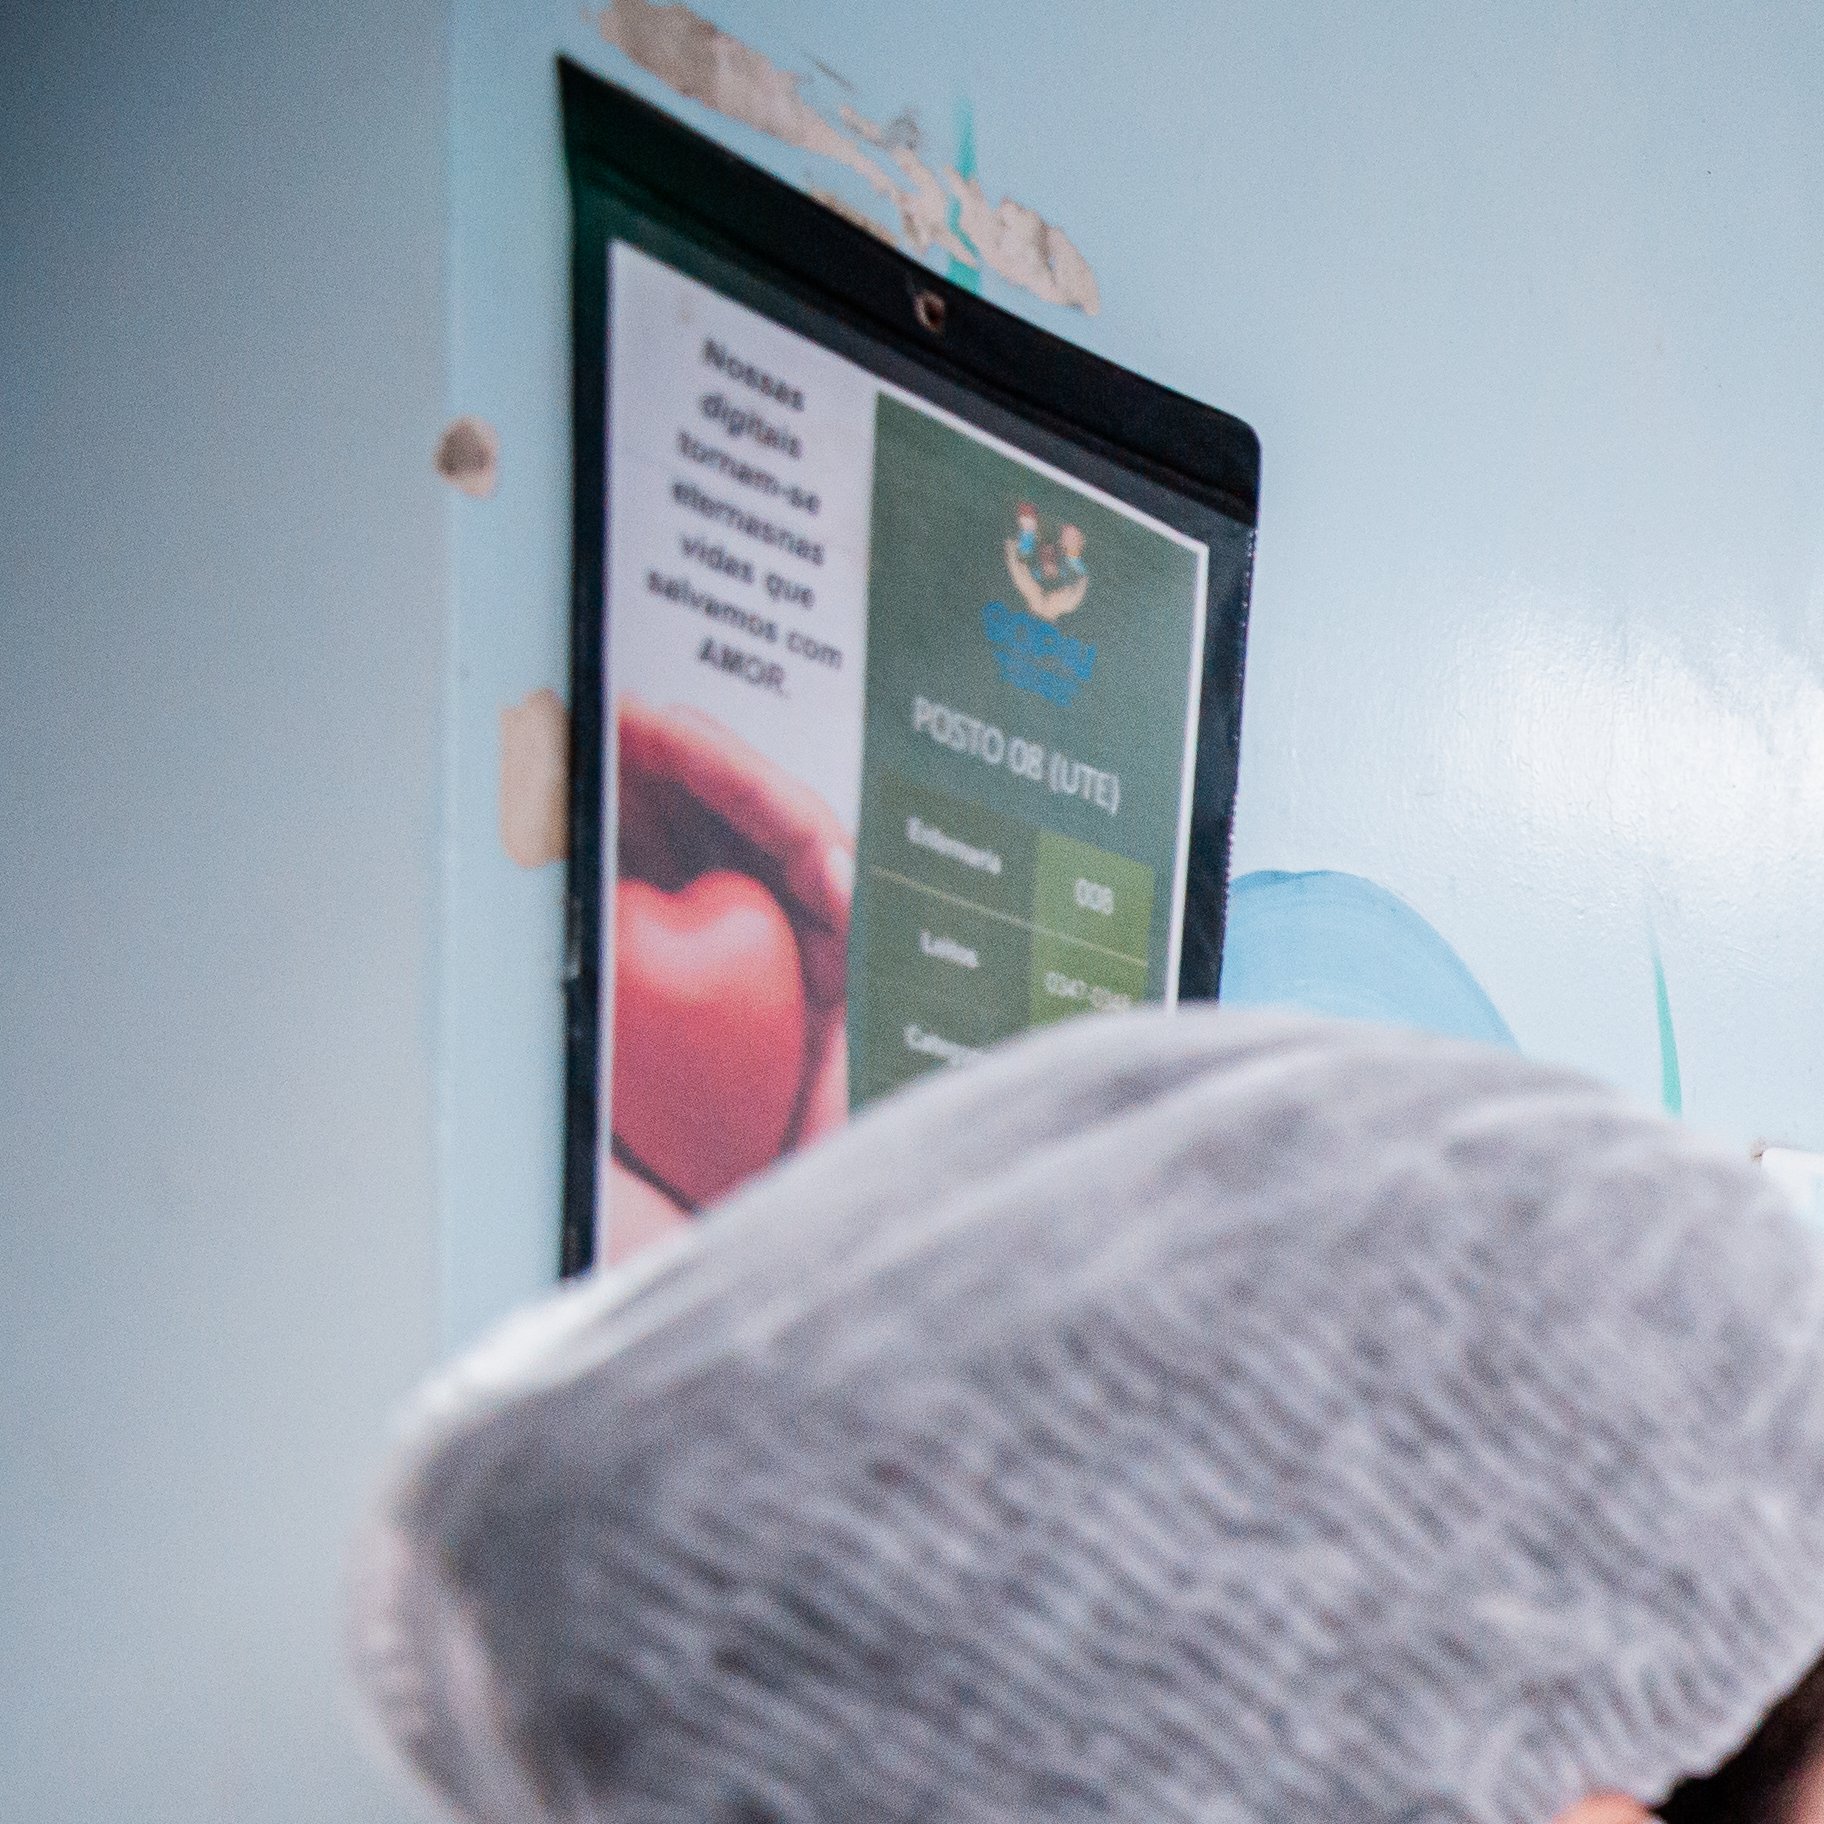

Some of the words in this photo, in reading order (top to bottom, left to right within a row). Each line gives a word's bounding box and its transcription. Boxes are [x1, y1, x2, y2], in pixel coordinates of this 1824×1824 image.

[703, 339, 805, 411] Nossas
[701, 391, 802, 459] digitais
[677, 429, 820, 513] tornam-se
[680, 533, 755, 584] vidas
[765, 572, 815, 609] que
[645, 568, 779, 643] salvamos
[786, 631, 843, 669] com
[912, 696, 1005, 766] POSTO
[1008, 737, 1044, 782] 08
[1048, 752, 1122, 818] (UTE)
